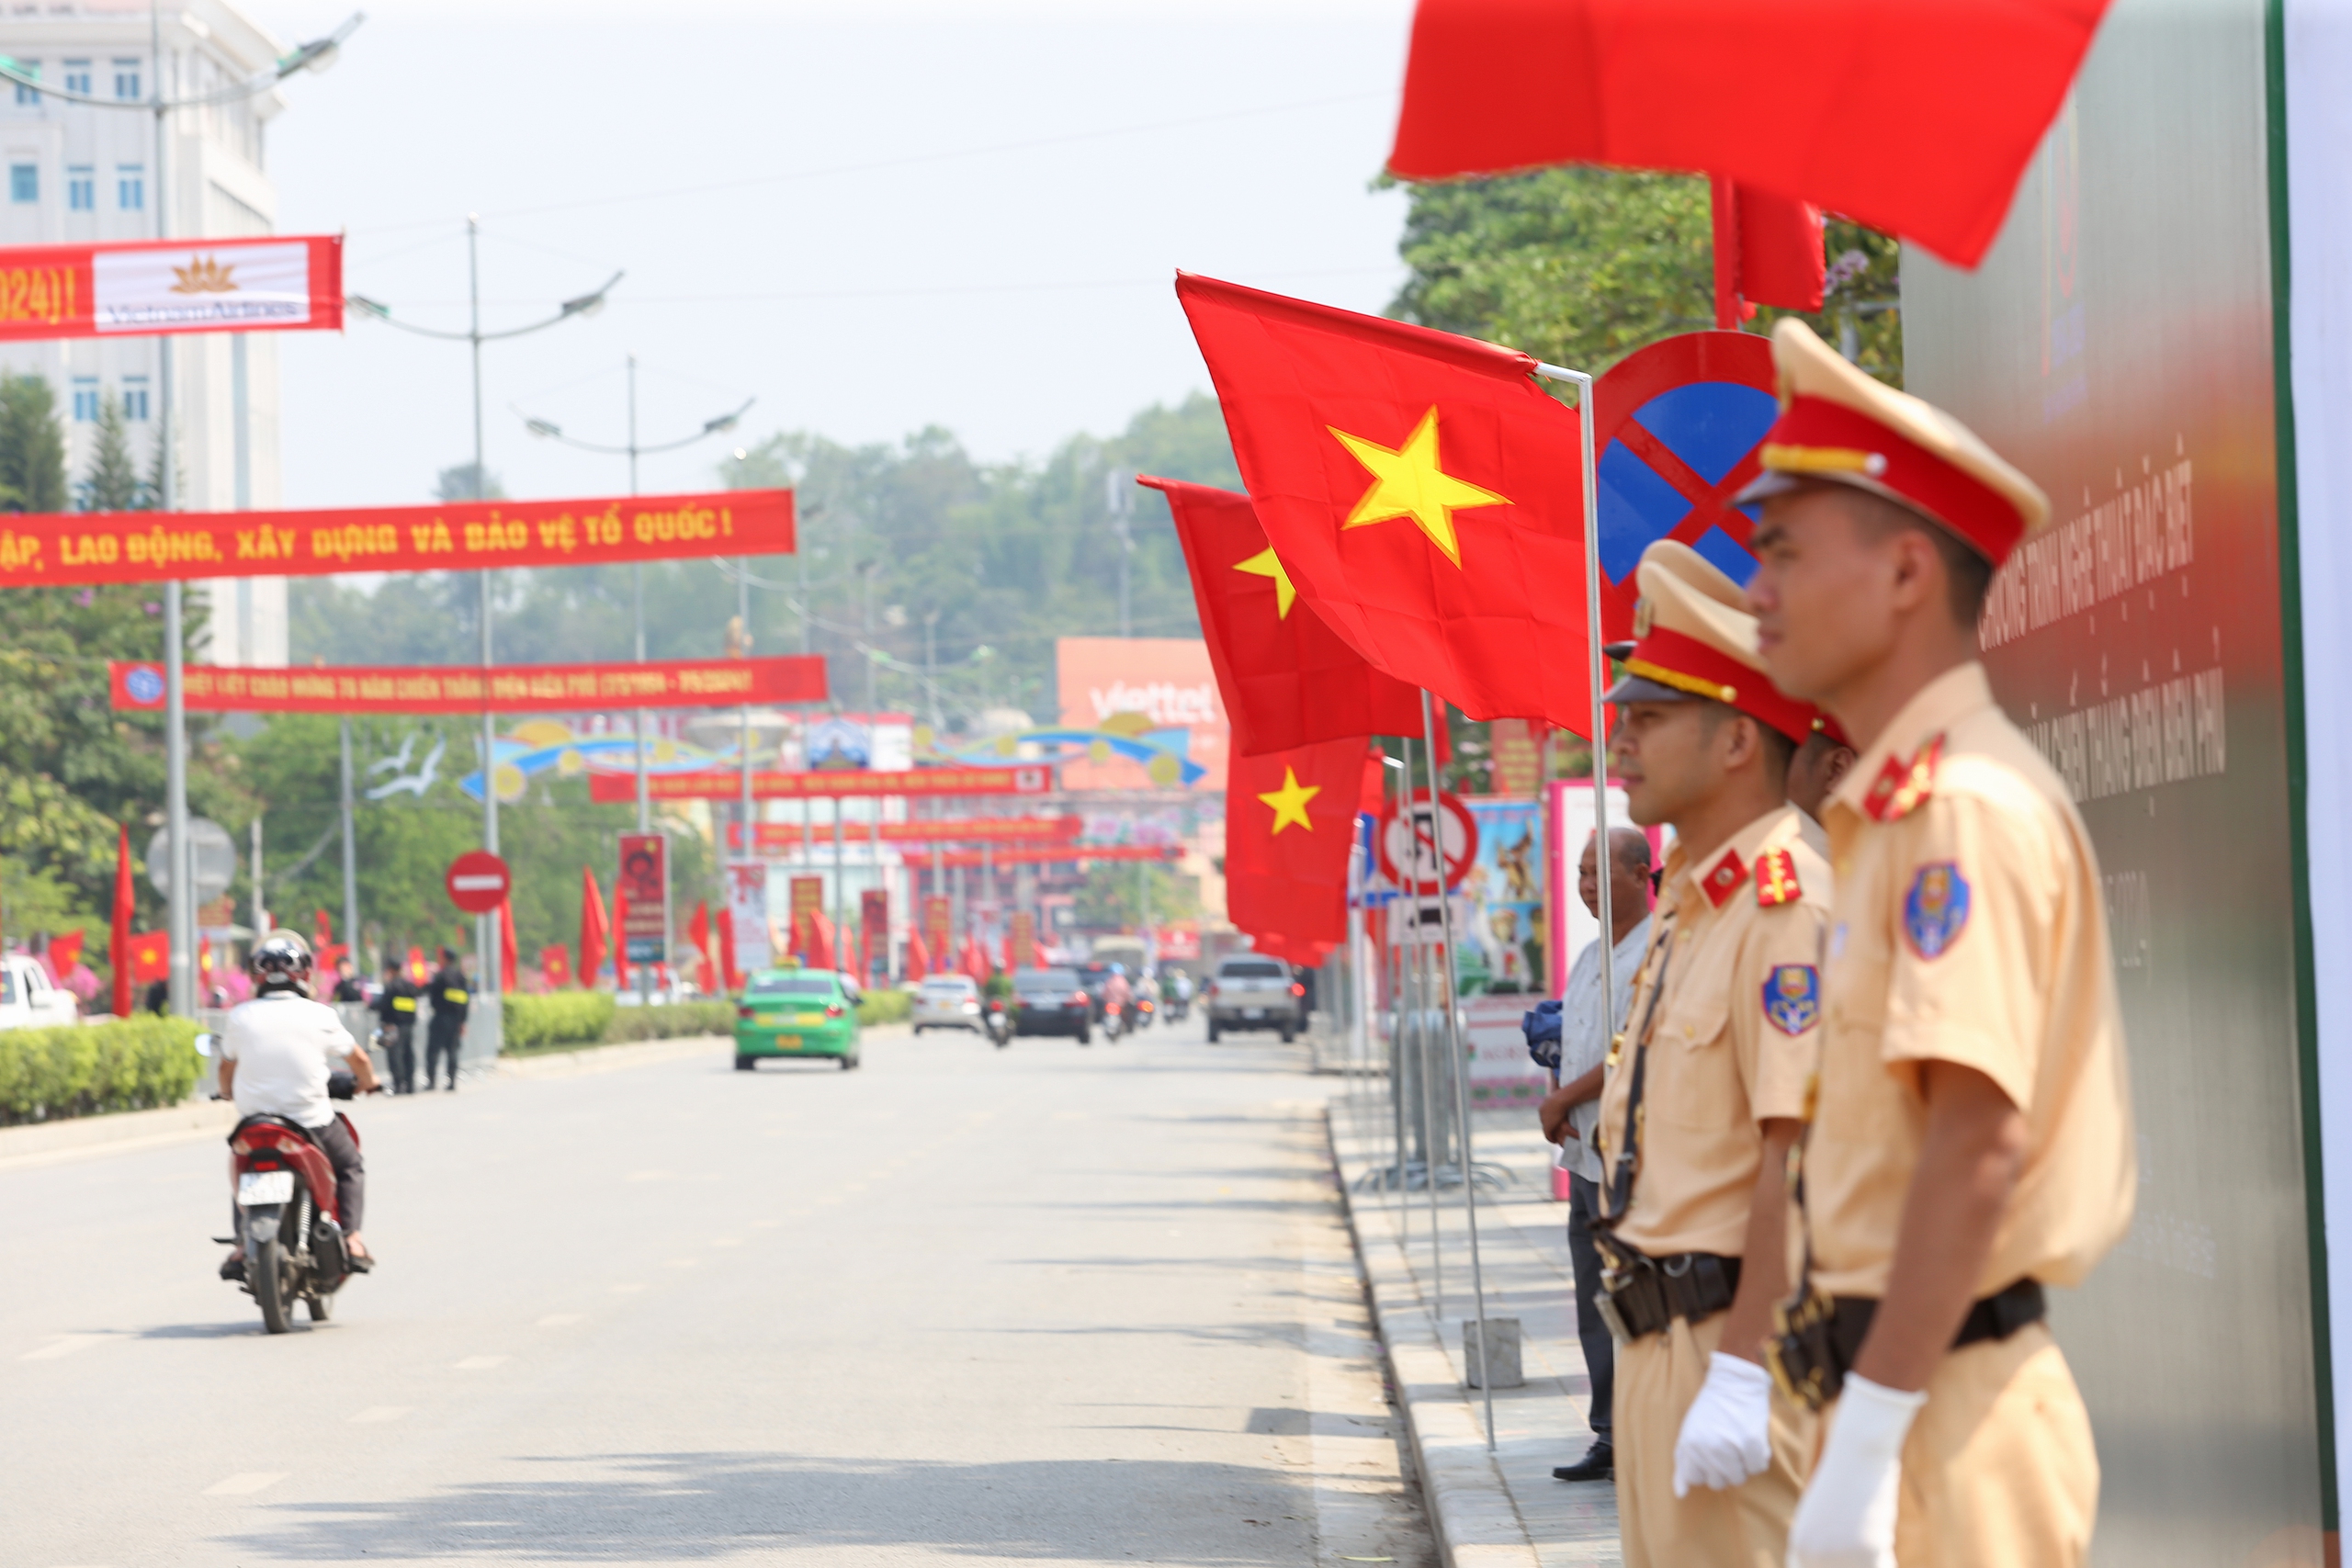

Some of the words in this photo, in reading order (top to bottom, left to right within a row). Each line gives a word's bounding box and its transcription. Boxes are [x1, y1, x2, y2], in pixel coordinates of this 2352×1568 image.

[60, 534, 119, 566] LAO
[126, 525, 223, 570] ĐỘNG,
[236, 523, 296, 559] XÂY
[411, 516, 454, 553] VÀ
[464, 509, 529, 552] BẢO
[537, 513, 577, 554] VỆ
